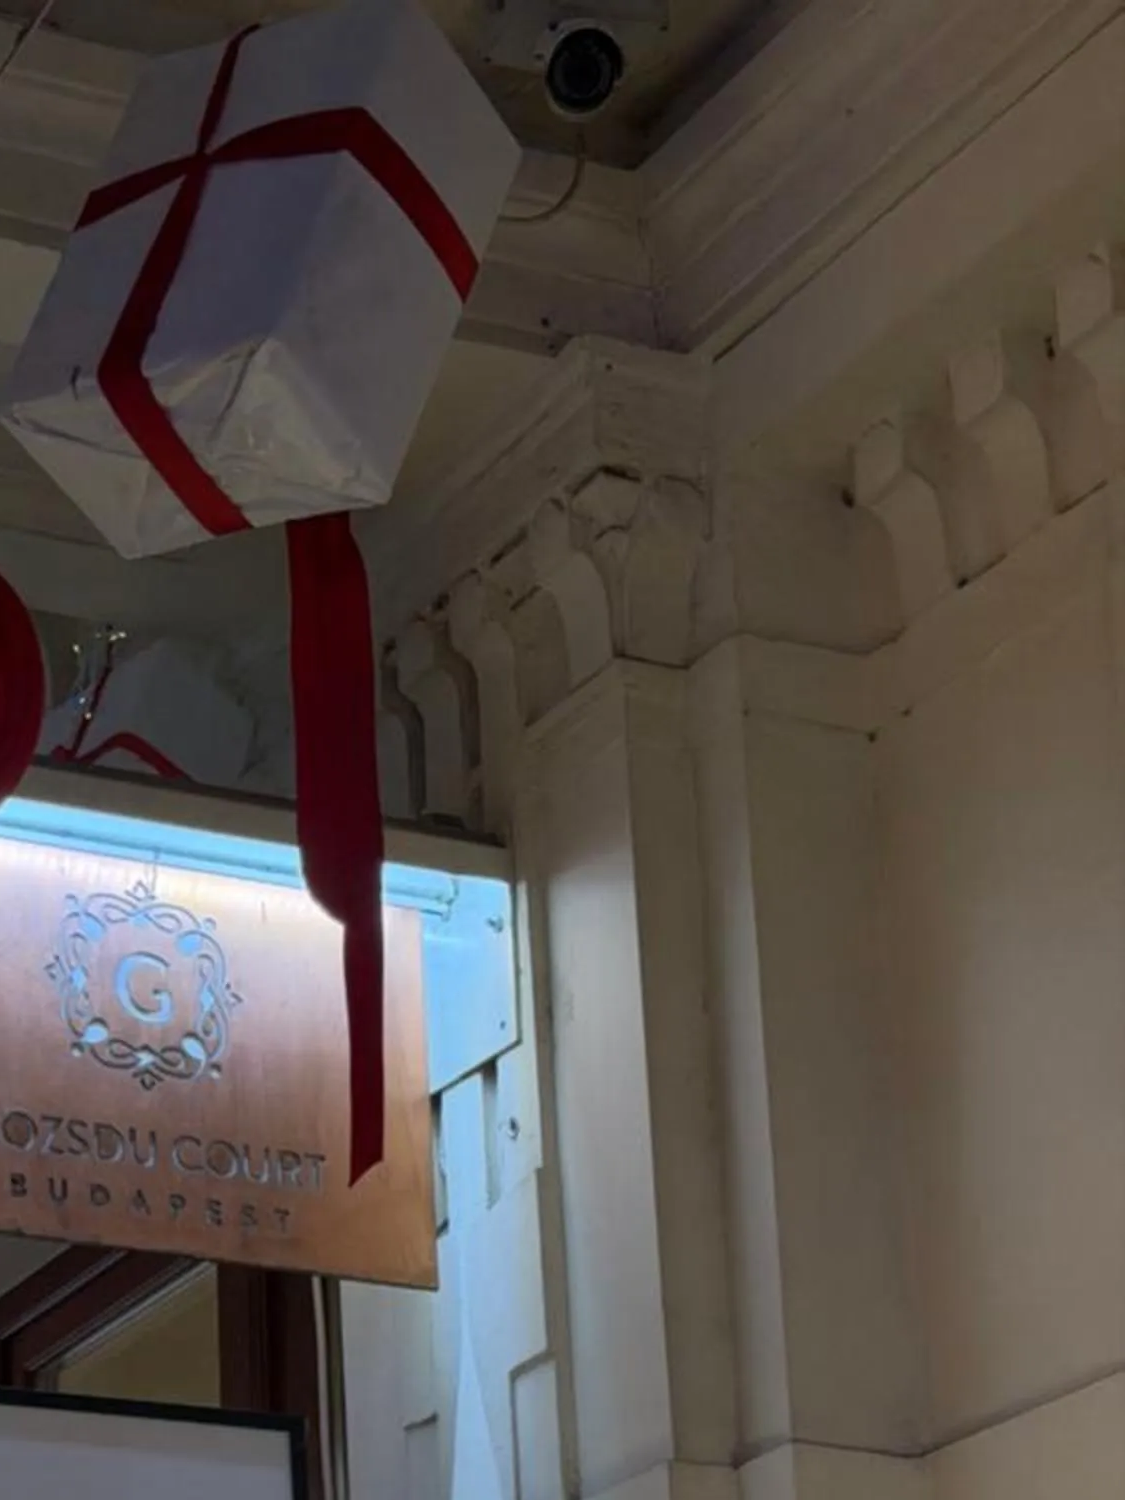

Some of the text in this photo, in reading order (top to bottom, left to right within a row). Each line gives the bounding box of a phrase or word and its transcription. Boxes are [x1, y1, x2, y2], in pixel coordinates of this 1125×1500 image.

[112, 950, 173, 1027] G
[171, 1134, 327, 1190] COURT
[8, 1171, 291, 1233] BUDAPEST
